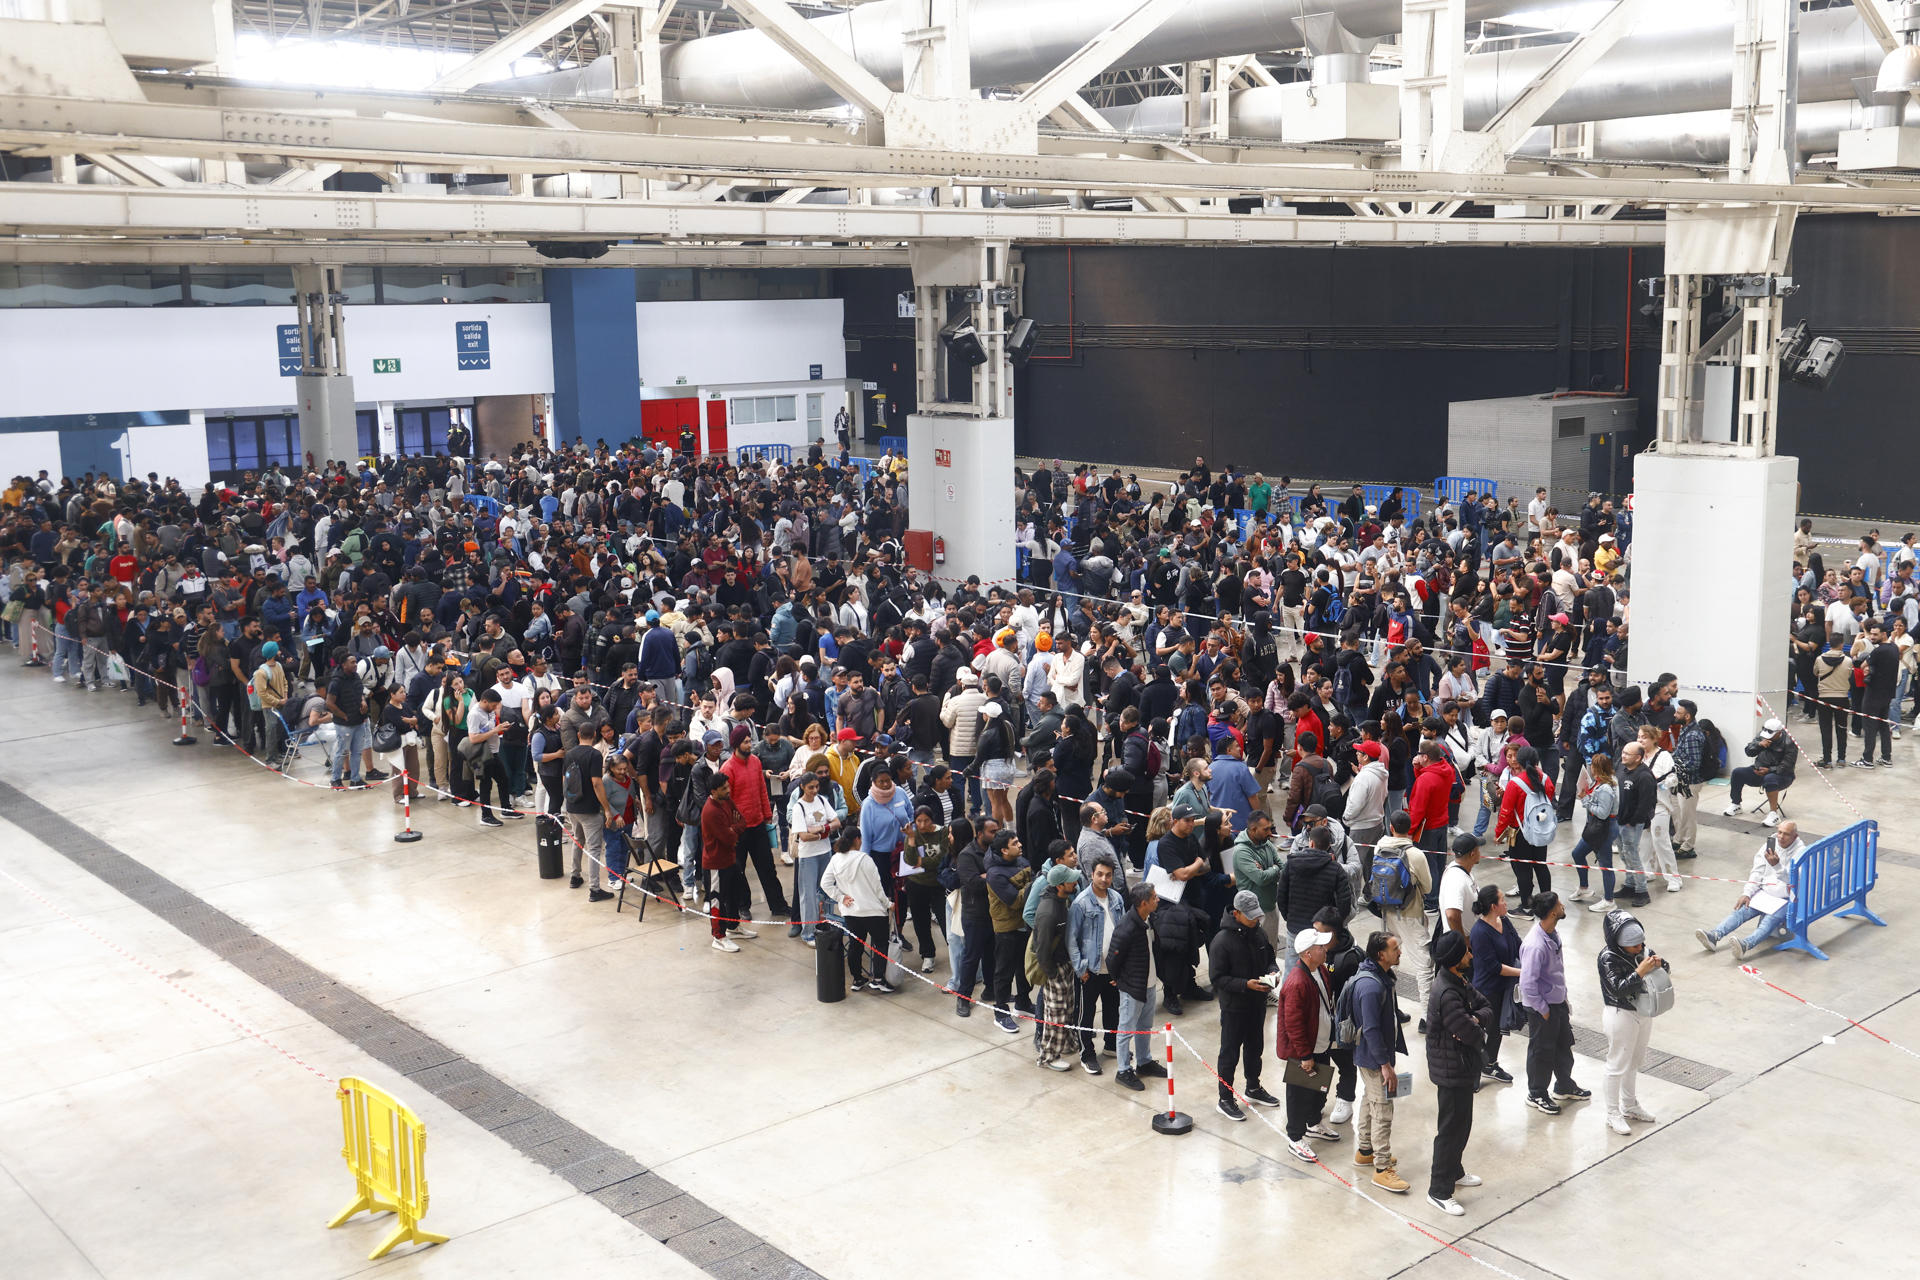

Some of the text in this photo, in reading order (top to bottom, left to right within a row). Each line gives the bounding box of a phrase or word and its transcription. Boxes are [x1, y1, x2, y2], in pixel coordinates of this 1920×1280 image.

[284, 327, 299, 335] sorti
[286, 336, 301, 344] sali
[463, 332, 481, 340] salida
